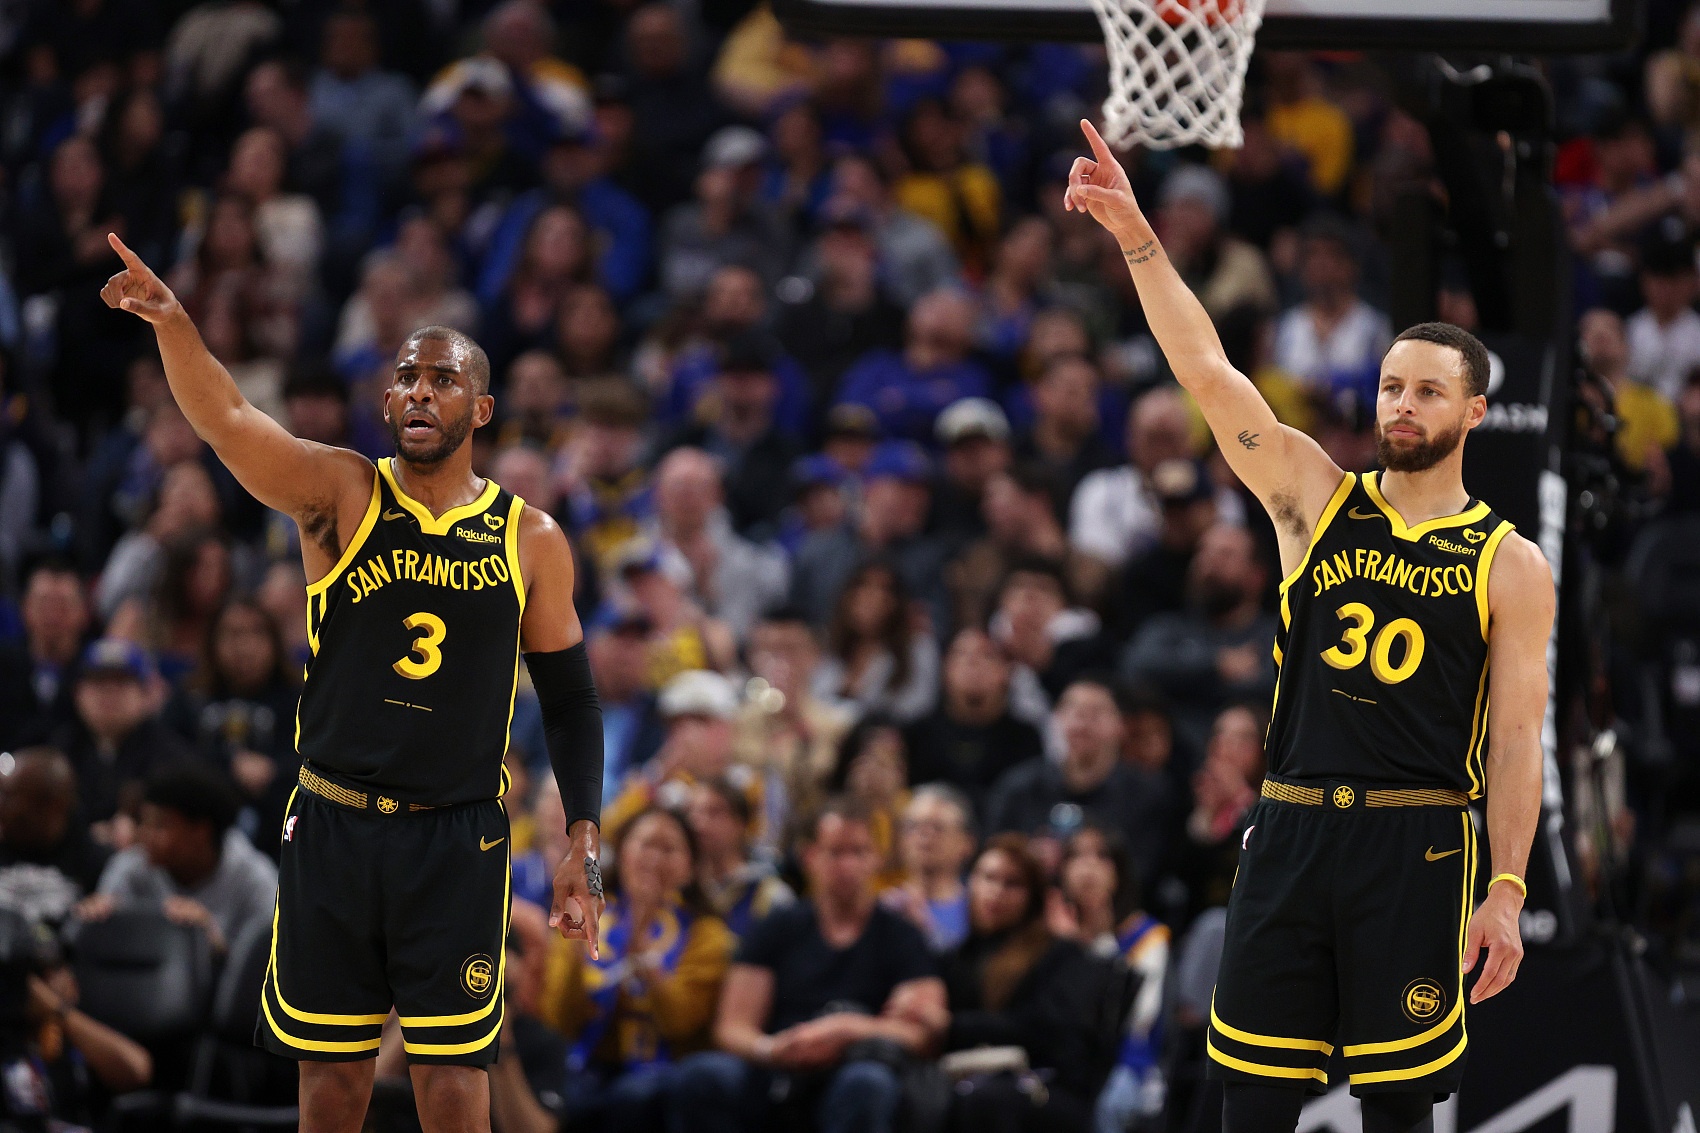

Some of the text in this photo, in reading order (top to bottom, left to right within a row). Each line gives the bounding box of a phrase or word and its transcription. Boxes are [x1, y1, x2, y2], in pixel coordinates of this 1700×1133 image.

[456, 526, 502, 544] Rakuten
[1428, 535, 1477, 556] Rakuten
[346, 549, 509, 603] SAN FRANCISCO
[1312, 548, 1473, 597] SAN FRANCISCO
[392, 611, 447, 680] 3
[1320, 602, 1425, 685] 30
